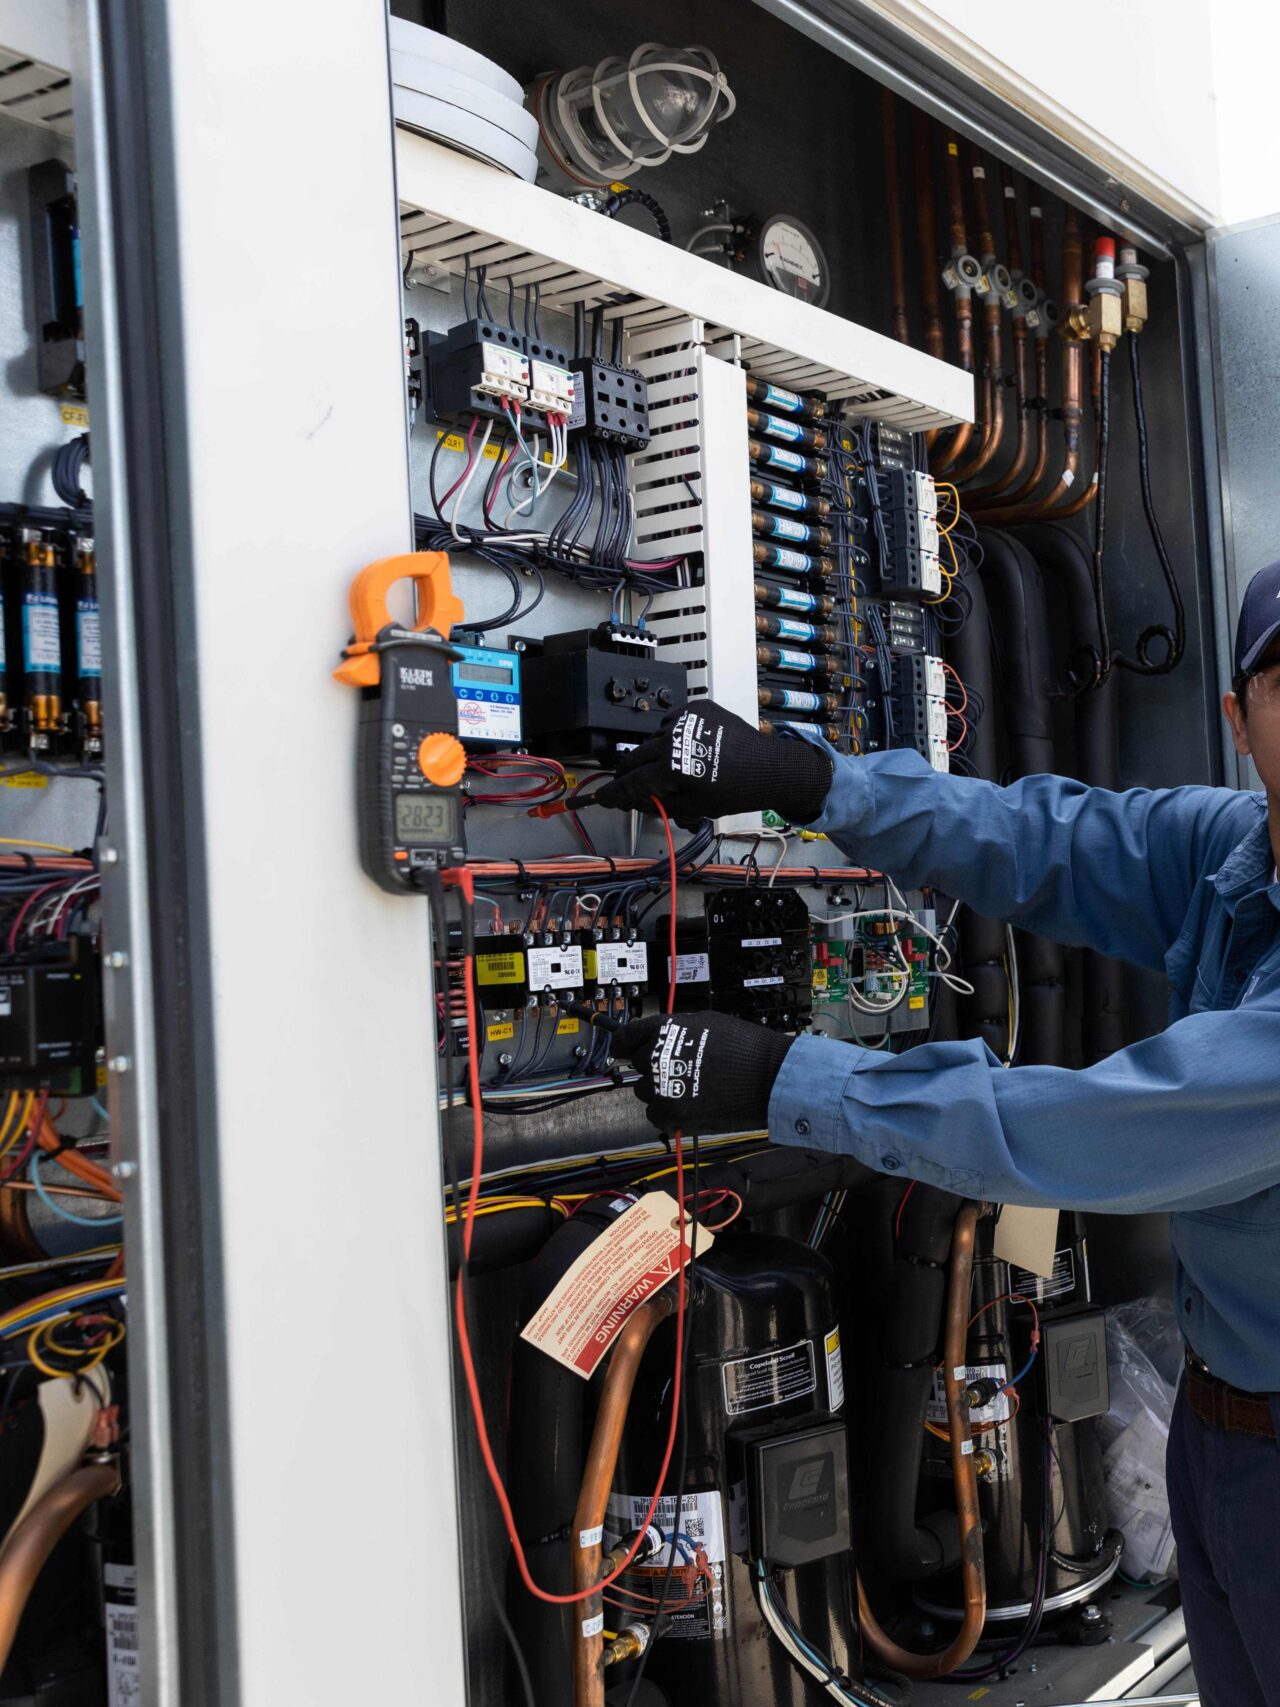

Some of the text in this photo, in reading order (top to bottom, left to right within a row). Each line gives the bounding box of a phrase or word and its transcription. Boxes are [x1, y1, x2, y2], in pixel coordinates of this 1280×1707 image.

[400, 667, 433, 677] KLEIN
[401, 675, 433, 686] TOOLS
[672, 712, 688, 771] TEKTYE
[711, 725, 724, 783] TOUCHSCREEN
[490, 1027, 512, 1037] HW-C1
[651, 1024, 667, 1095] TEKTYE
[692, 1028, 709, 1097] TOUCHSCREEN
[674, 1083, 680, 1094] A4
[595, 1278, 654, 1344] WARNING
[749, 1352, 795, 1370] Copeland Scroll
